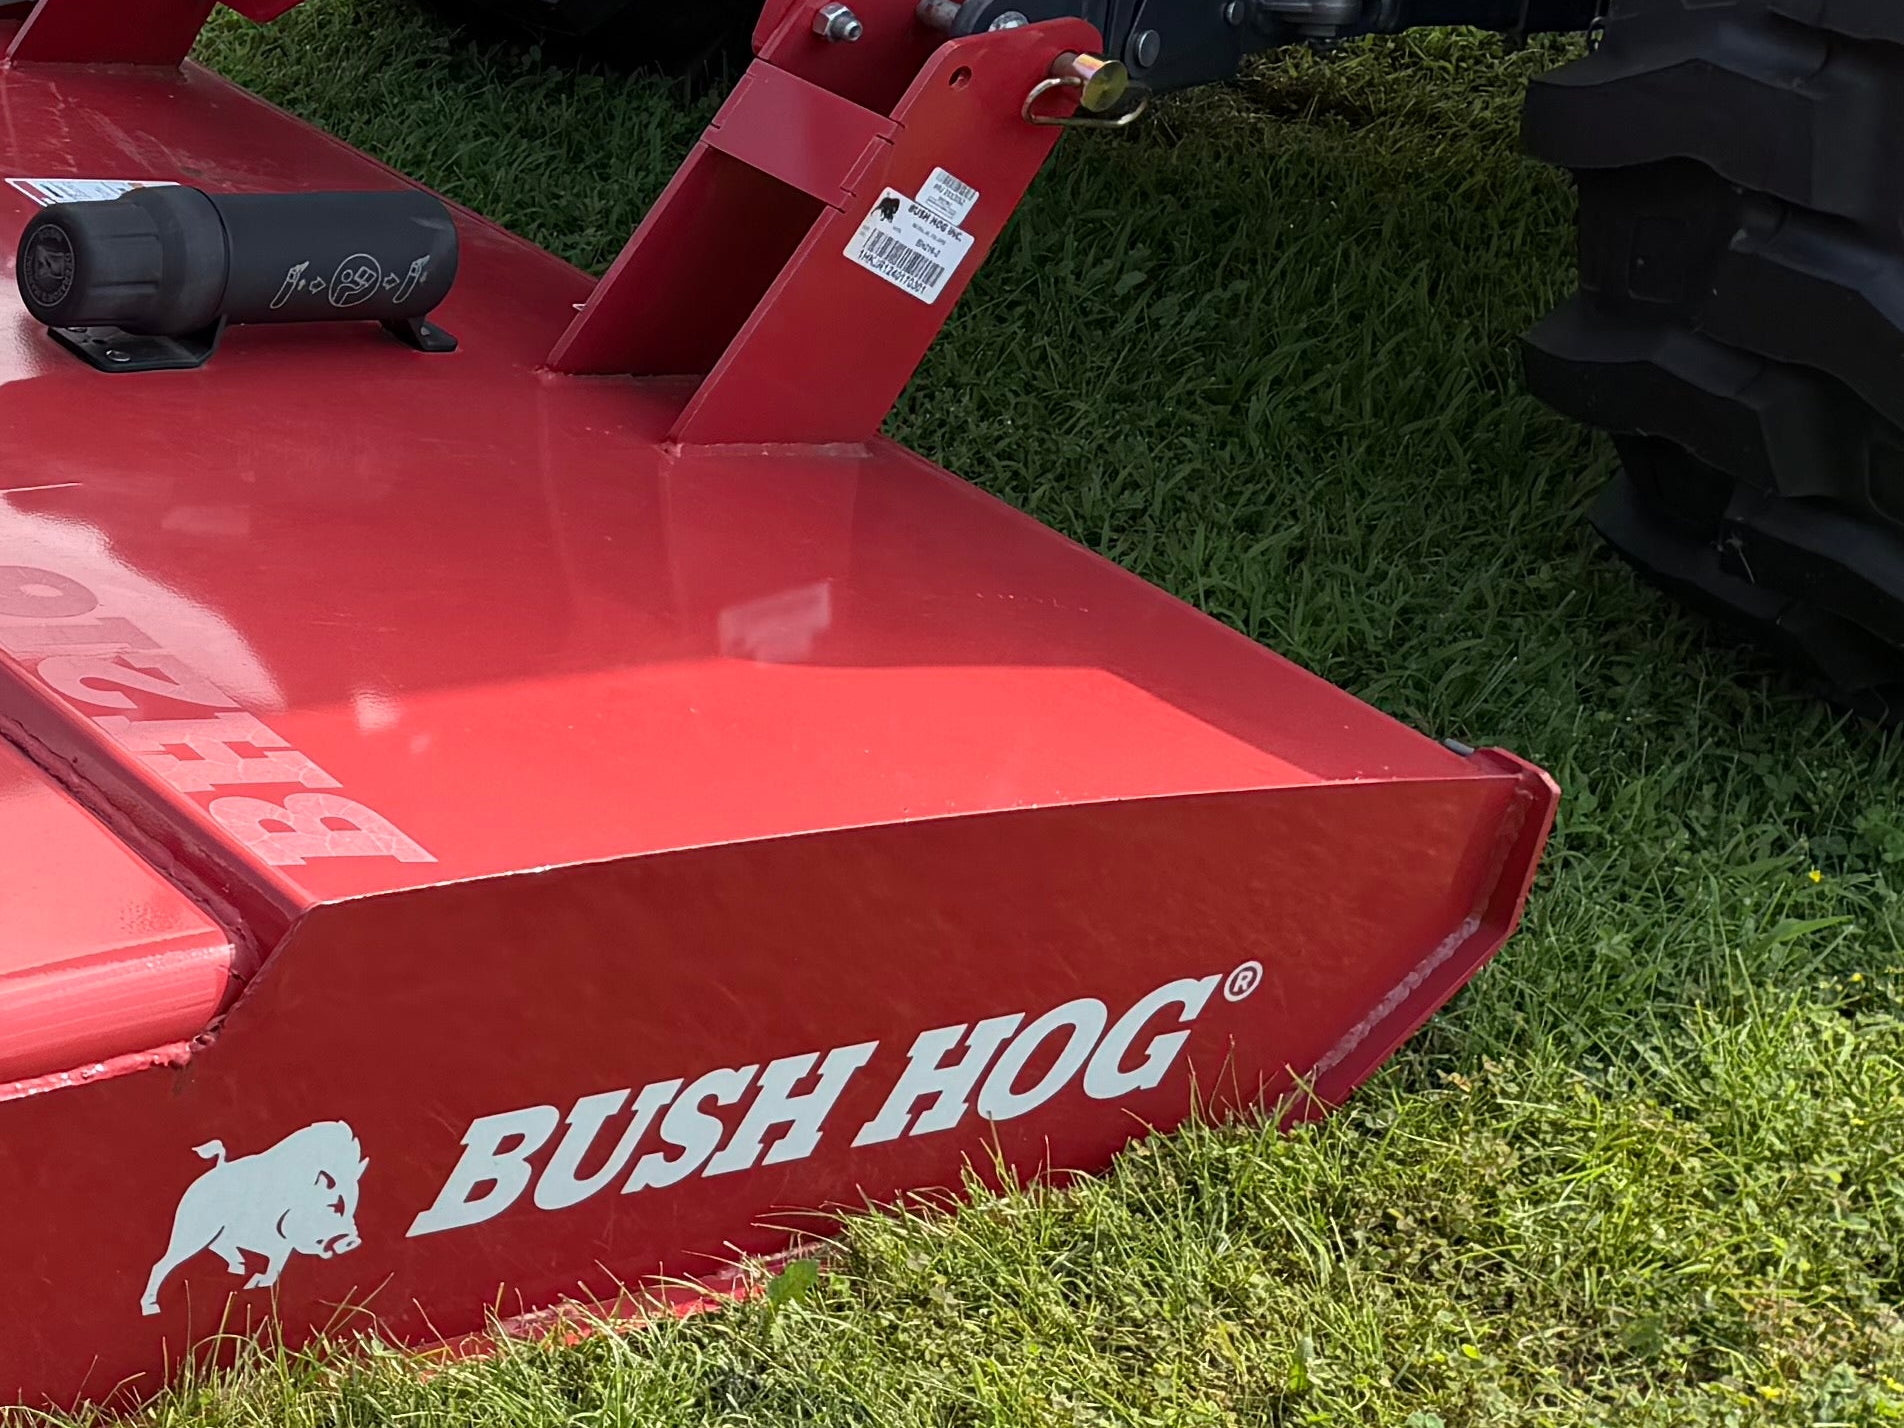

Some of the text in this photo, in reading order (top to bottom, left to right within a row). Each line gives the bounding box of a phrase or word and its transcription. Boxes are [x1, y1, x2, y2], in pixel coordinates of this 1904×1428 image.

[907, 204, 930, 224] BUSH
[928, 216, 949, 235] HOG
[406, 1040, 880, 1237] BUSH
